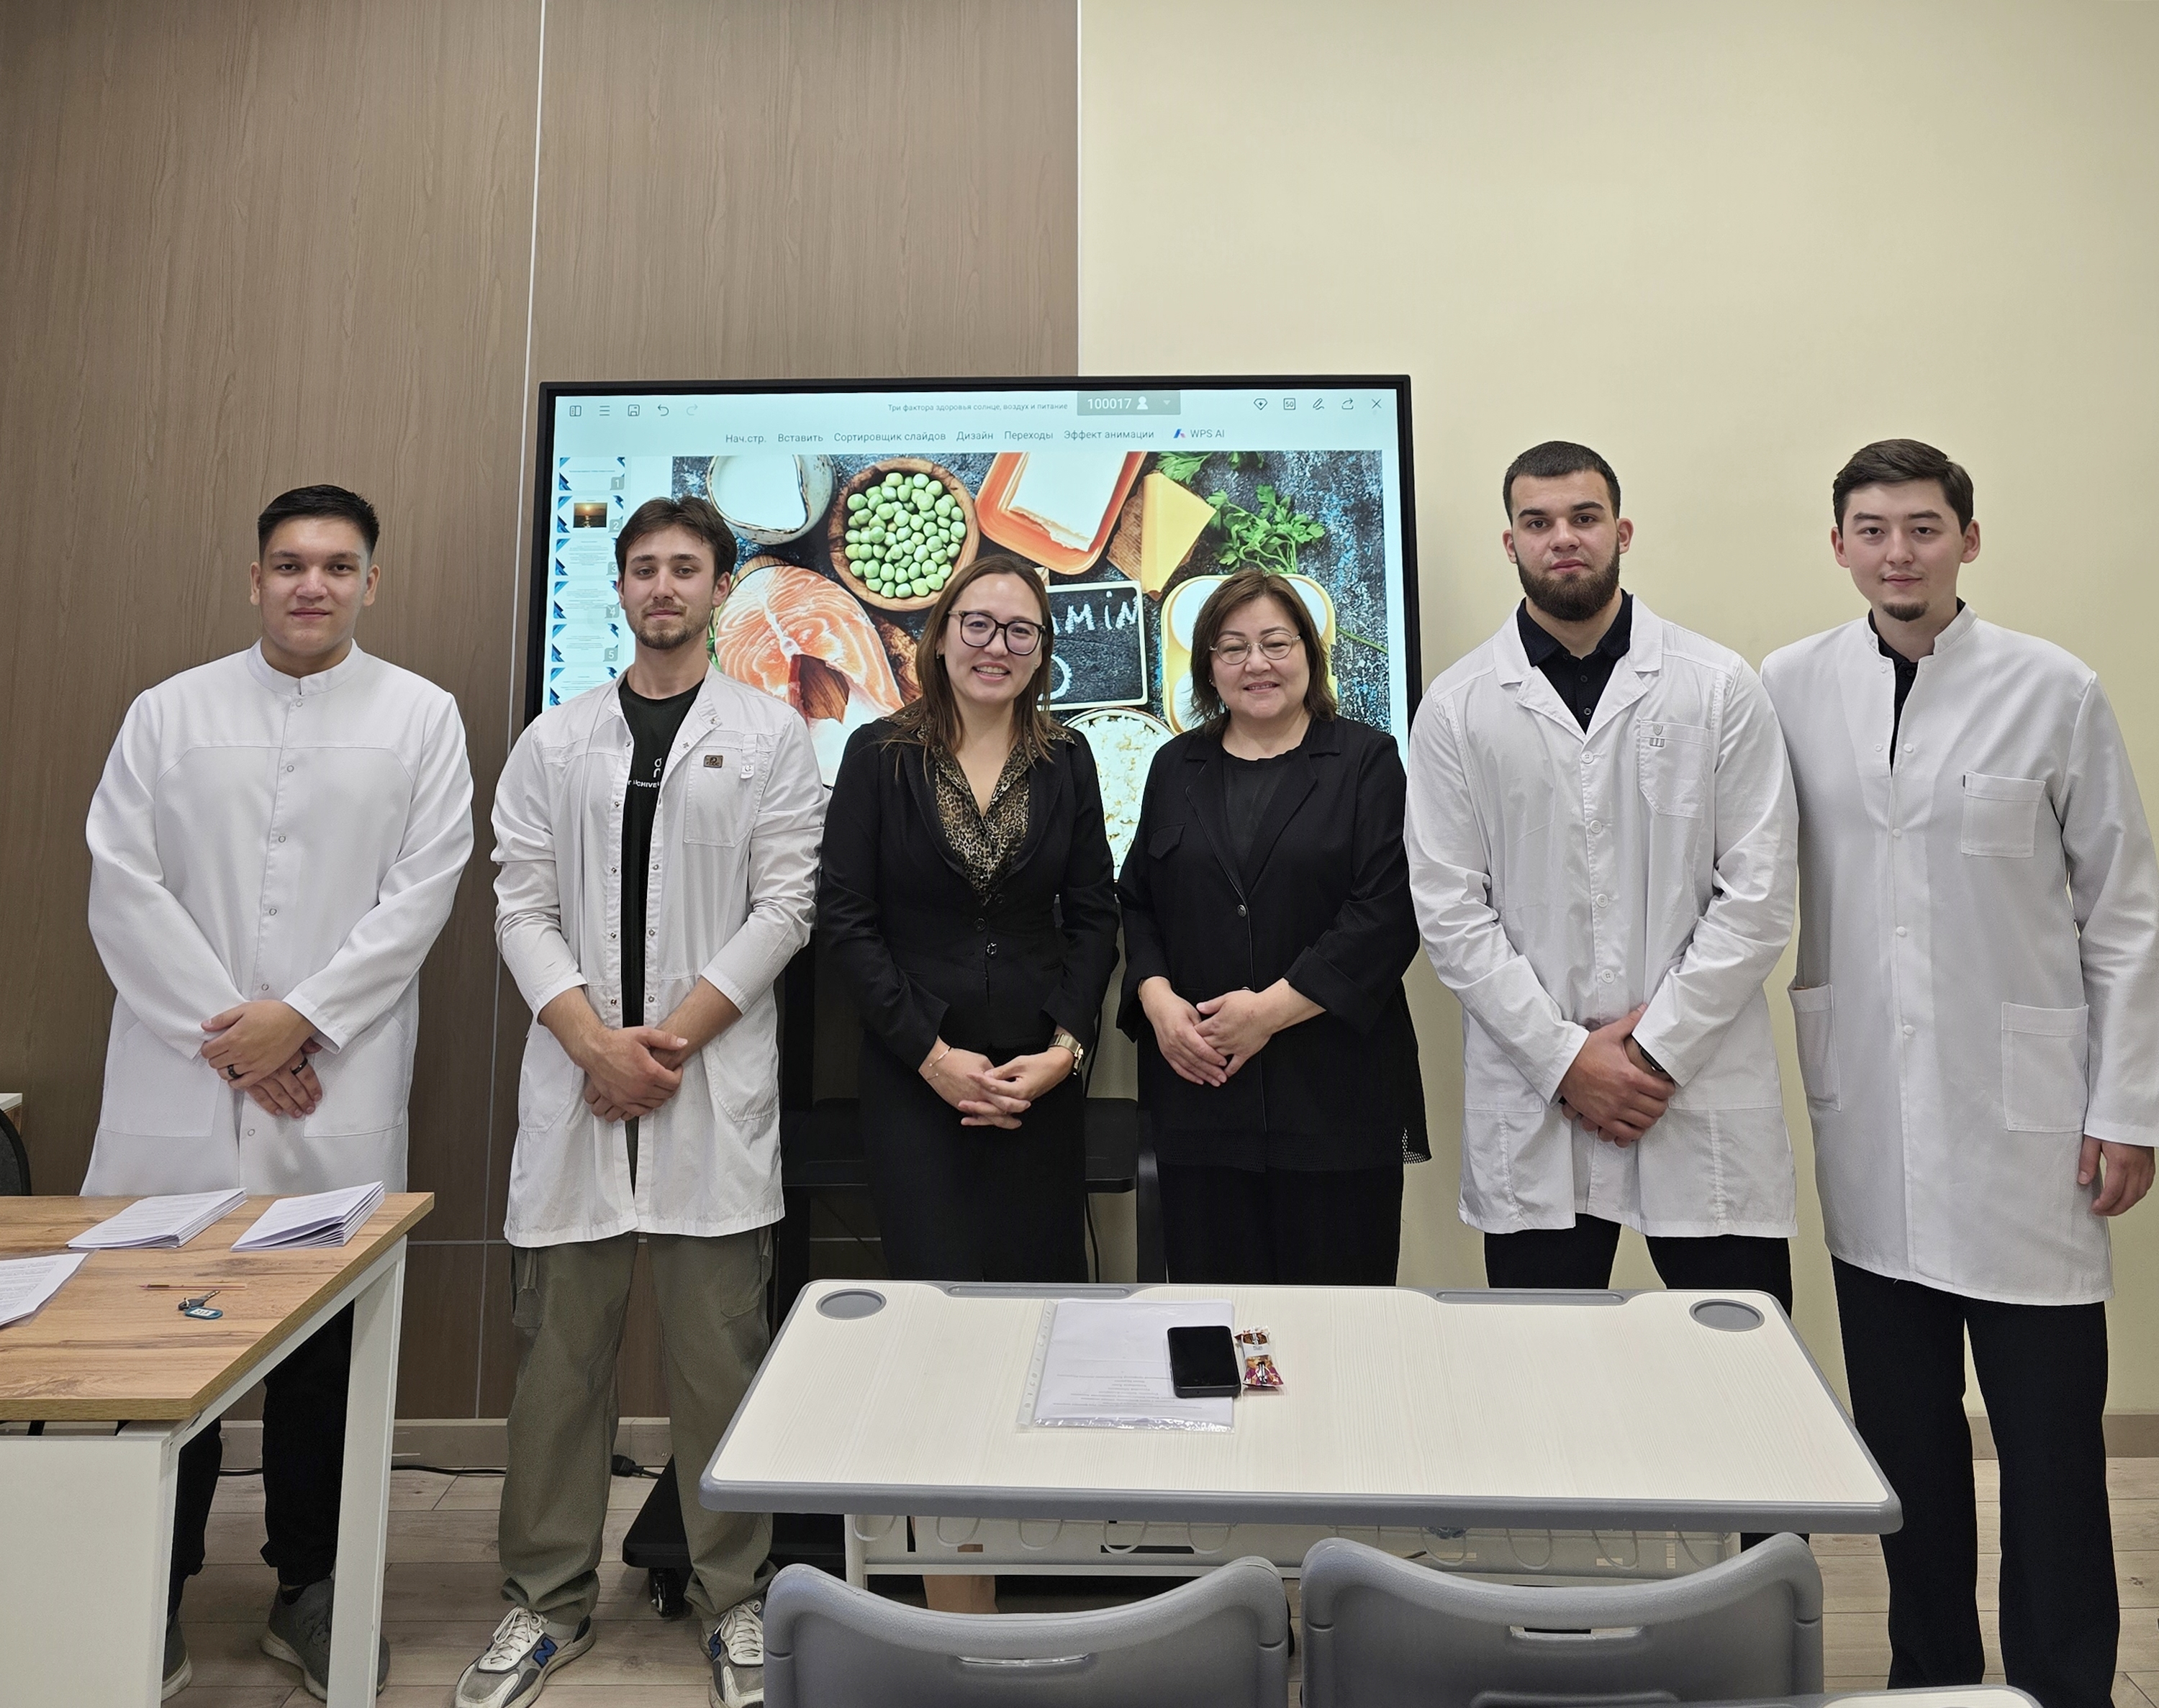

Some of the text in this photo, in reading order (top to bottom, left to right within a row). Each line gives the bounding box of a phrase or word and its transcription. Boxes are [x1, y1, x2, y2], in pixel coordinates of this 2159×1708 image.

[902, 404, 934, 412] фактора
[1087, 398, 1132, 409] 100017
[778, 433, 823, 442] Вставить
[834, 432, 946, 443] Сортировщик слайдов
[956, 431, 993, 442] Дизайн
[1005, 431, 1053, 441] Переходы
[1064, 430, 1154, 440] Эффект анимации
[1190, 430, 1225, 438] WPS AI
[725, 434, 766, 445] Нач.стр.
[612, 522, 620, 531] 2
[608, 650, 615, 659] 5
